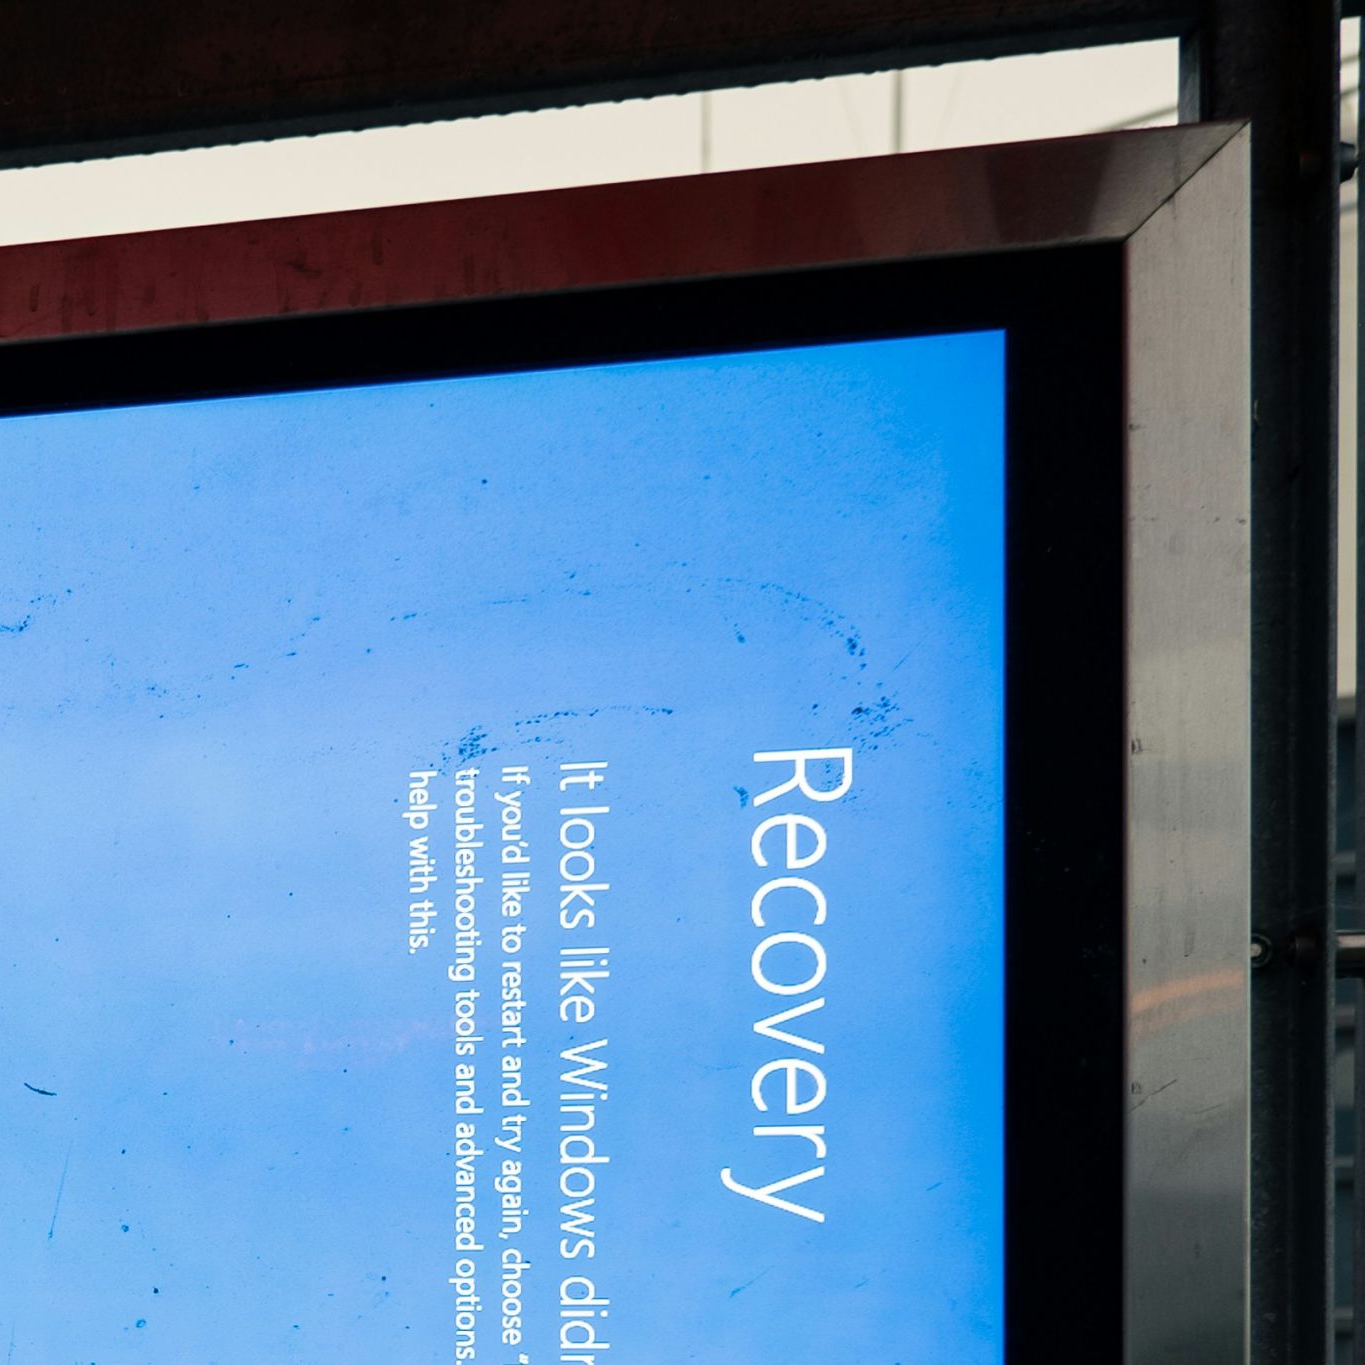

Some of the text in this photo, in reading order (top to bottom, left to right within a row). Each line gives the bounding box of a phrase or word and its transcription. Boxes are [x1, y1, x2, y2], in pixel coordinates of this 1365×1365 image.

[501, 765, 531, 786] If
[559, 761, 609, 792] It
[402, 770, 439, 954] help with this.
[446, 767, 485, 983] troubleshooting
[501, 872, 531, 918] like
[559, 805, 610, 929] looks
[501, 923, 527, 954] to
[454, 988, 485, 1056] tools
[501, 961, 527, 1049] restart
[559, 947, 611, 1023] like
[720, 747, 855, 1224] Recovery
[454, 1063, 485, 1115] and
[501, 1055, 531, 1107] and
[493, 1113, 528, 1153] try
[559, 1038, 611, 1259] Windows
[454, 1121, 485, 1251] advanced
[493, 1159, 530, 1240] again,
[501, 1248, 531, 1346] choose
